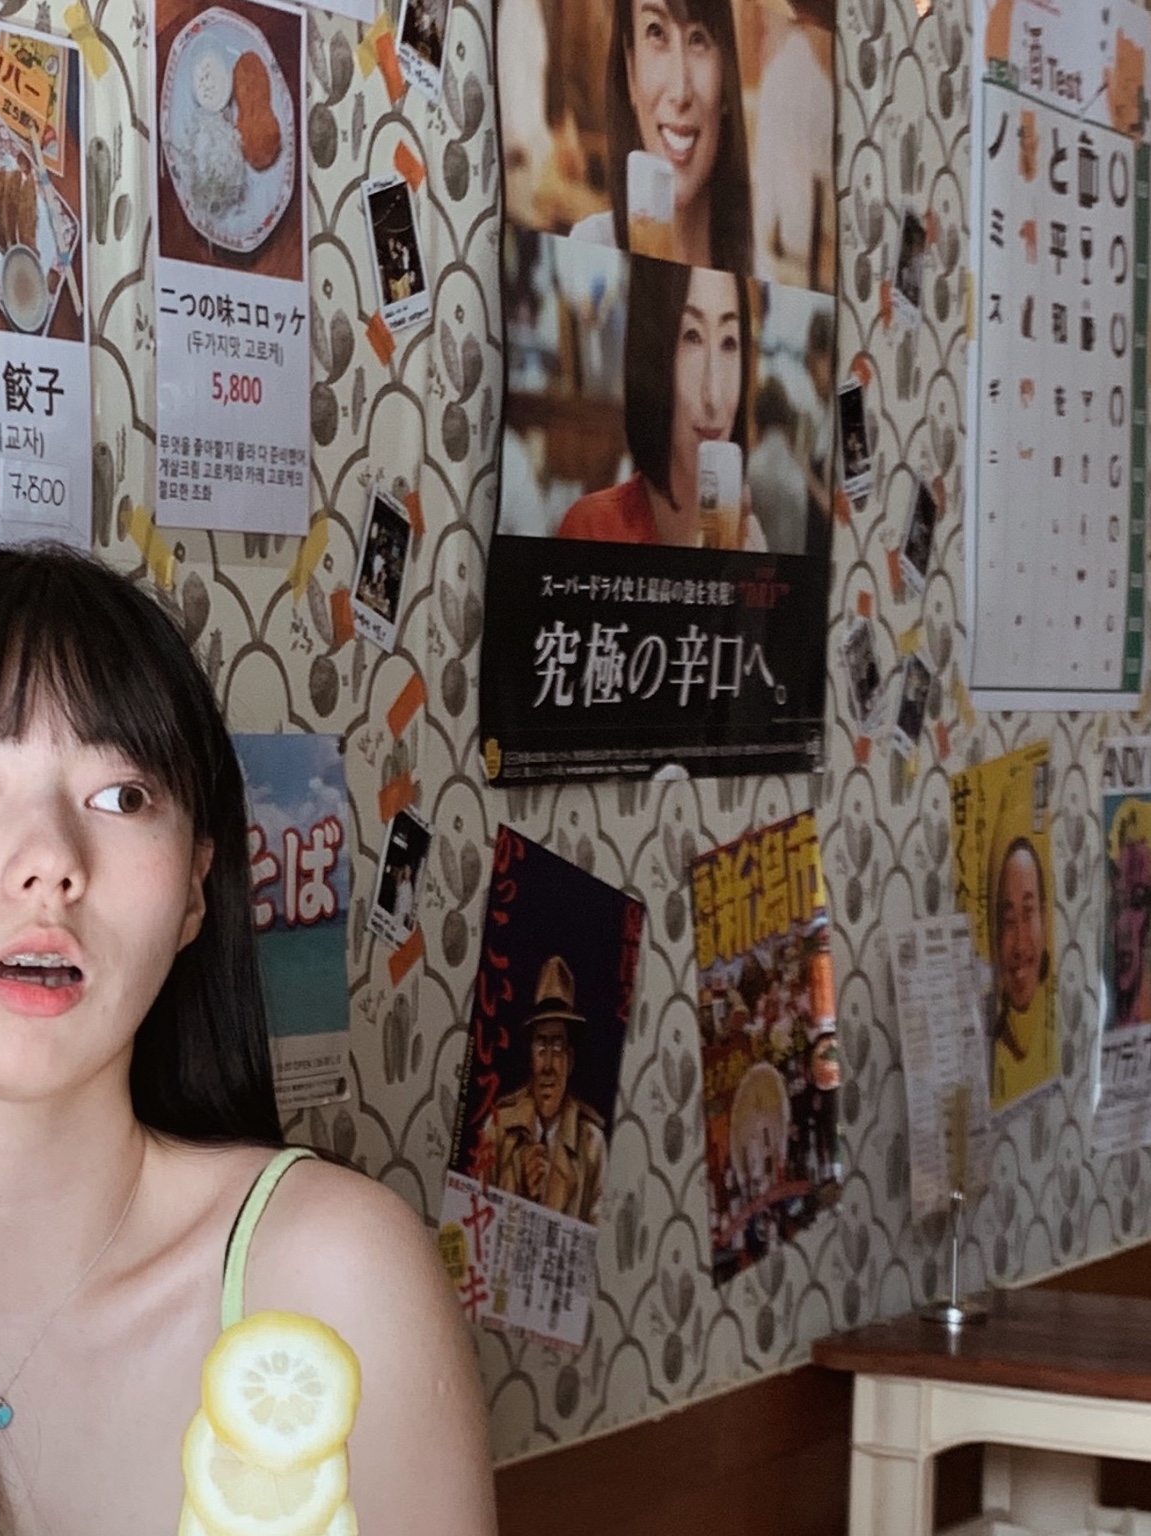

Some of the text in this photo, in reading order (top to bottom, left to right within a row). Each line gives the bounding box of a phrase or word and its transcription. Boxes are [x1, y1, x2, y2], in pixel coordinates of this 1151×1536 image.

[159, 287, 306, 337] 二つの味コロッケ
[187, 329, 284, 367] (두가지맛 고로케)
[211, 371, 263, 407] 5,800
[160, 434, 191, 457] 무엇을
[193, 437, 234, 461] 좋아할지
[533, 619, 788, 708] 究極の辛口へ。
